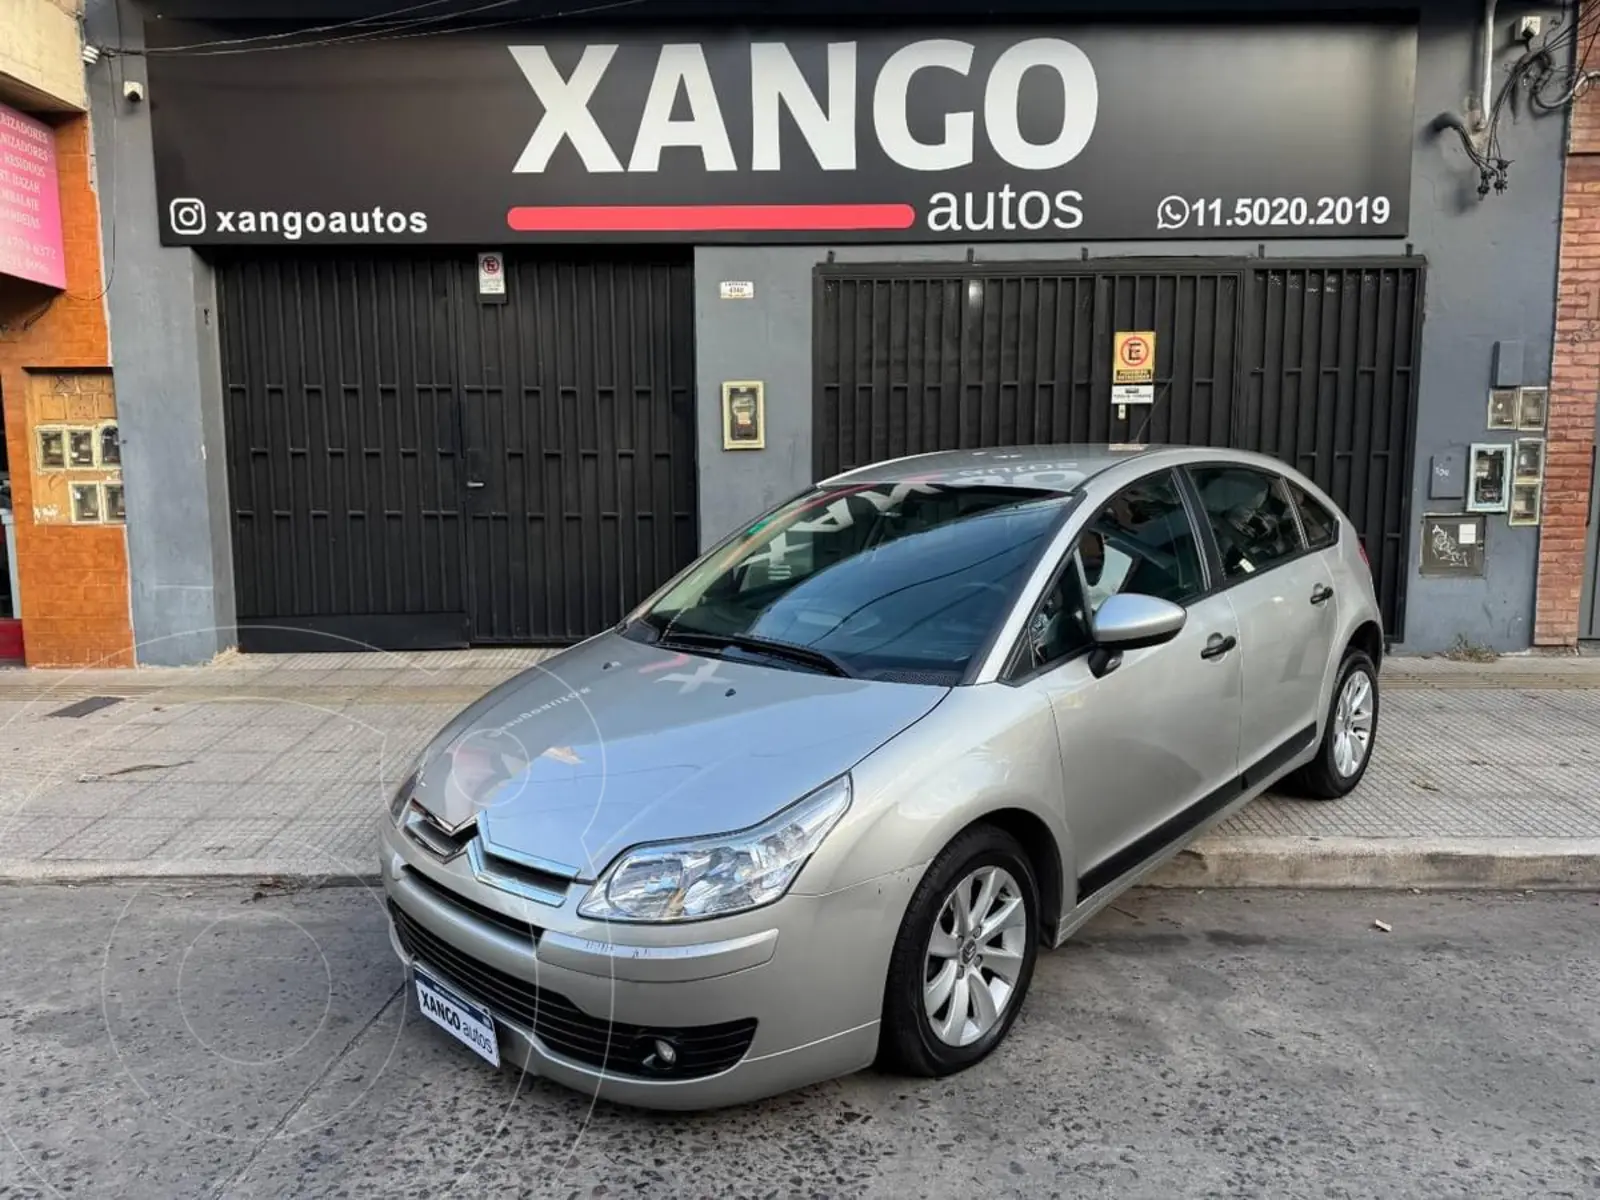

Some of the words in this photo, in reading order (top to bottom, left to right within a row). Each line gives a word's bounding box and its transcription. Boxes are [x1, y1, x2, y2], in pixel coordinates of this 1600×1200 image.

[507, 37, 1099, 172] XANGO
[215, 205, 428, 240] xangoautos
[926, 183, 1084, 231] autos
[1191, 195, 1391, 226] 11.5020.2019
[462, 1021, 493, 1054] autos
